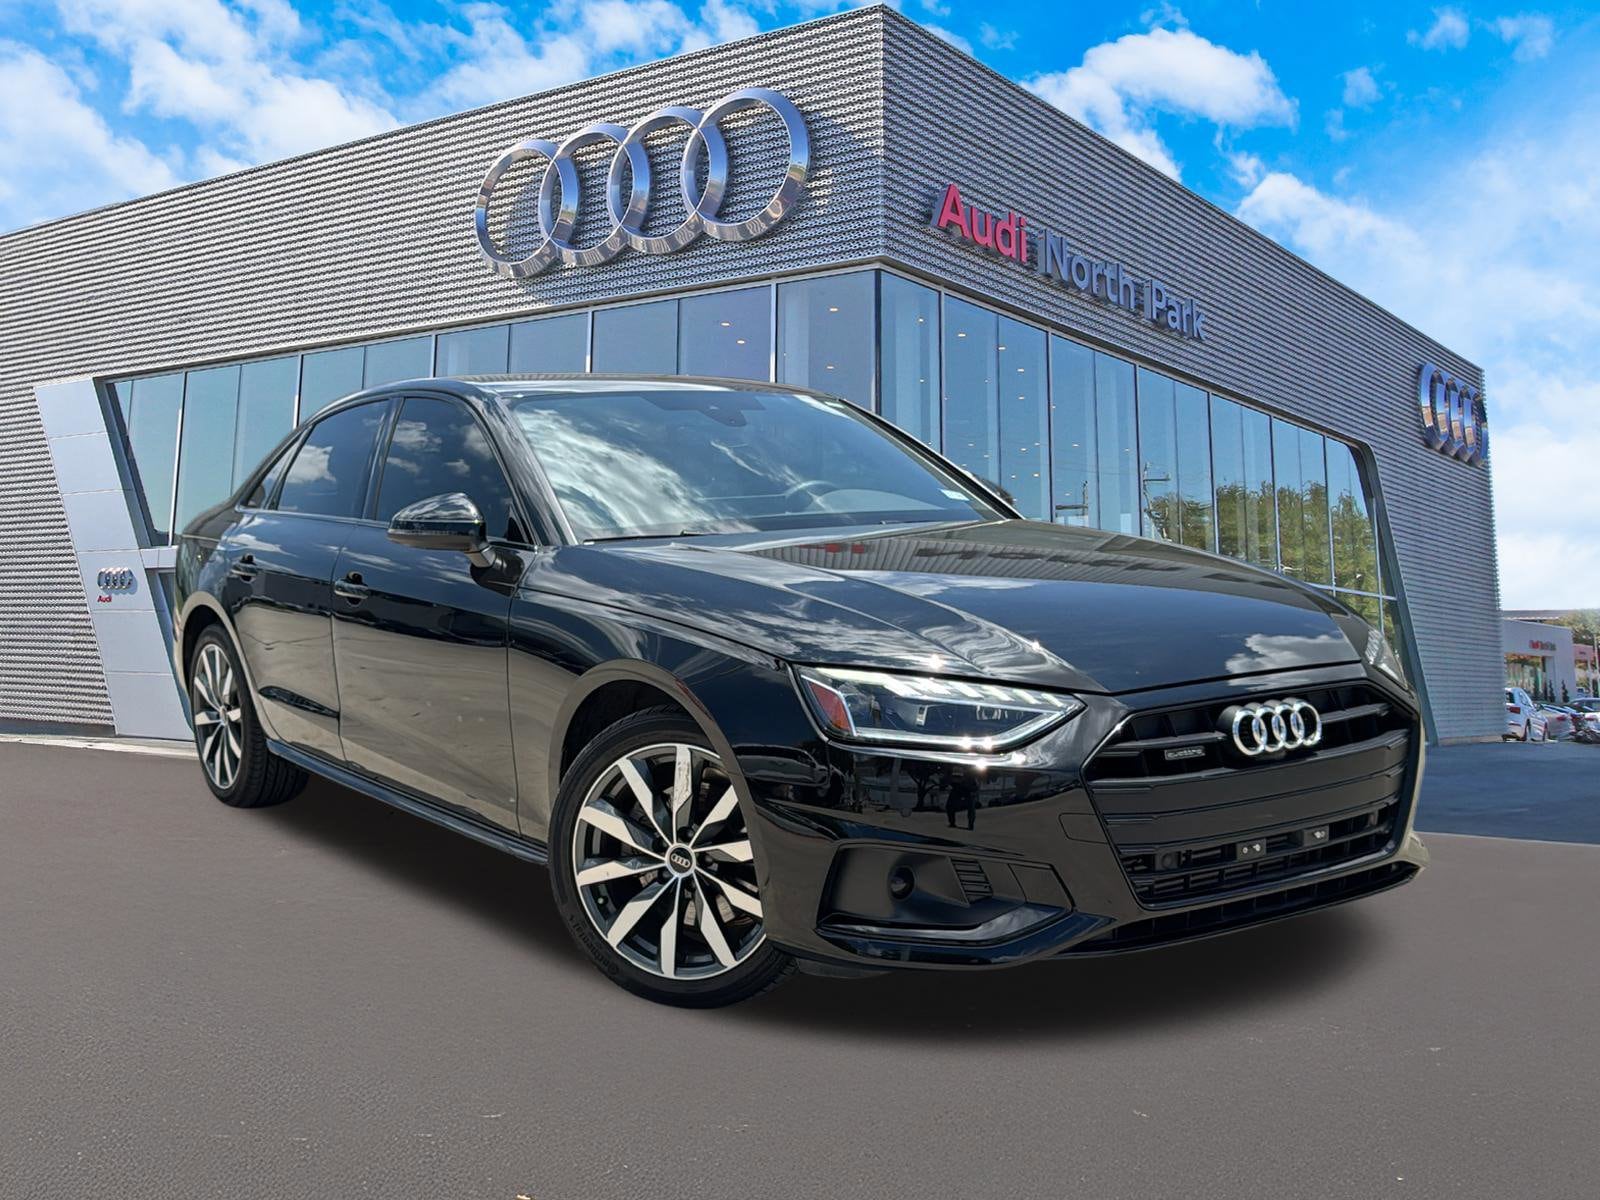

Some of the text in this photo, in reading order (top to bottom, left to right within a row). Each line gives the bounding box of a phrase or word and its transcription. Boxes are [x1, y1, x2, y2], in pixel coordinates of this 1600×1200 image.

[935, 183, 1206, 341] Audi North Park
